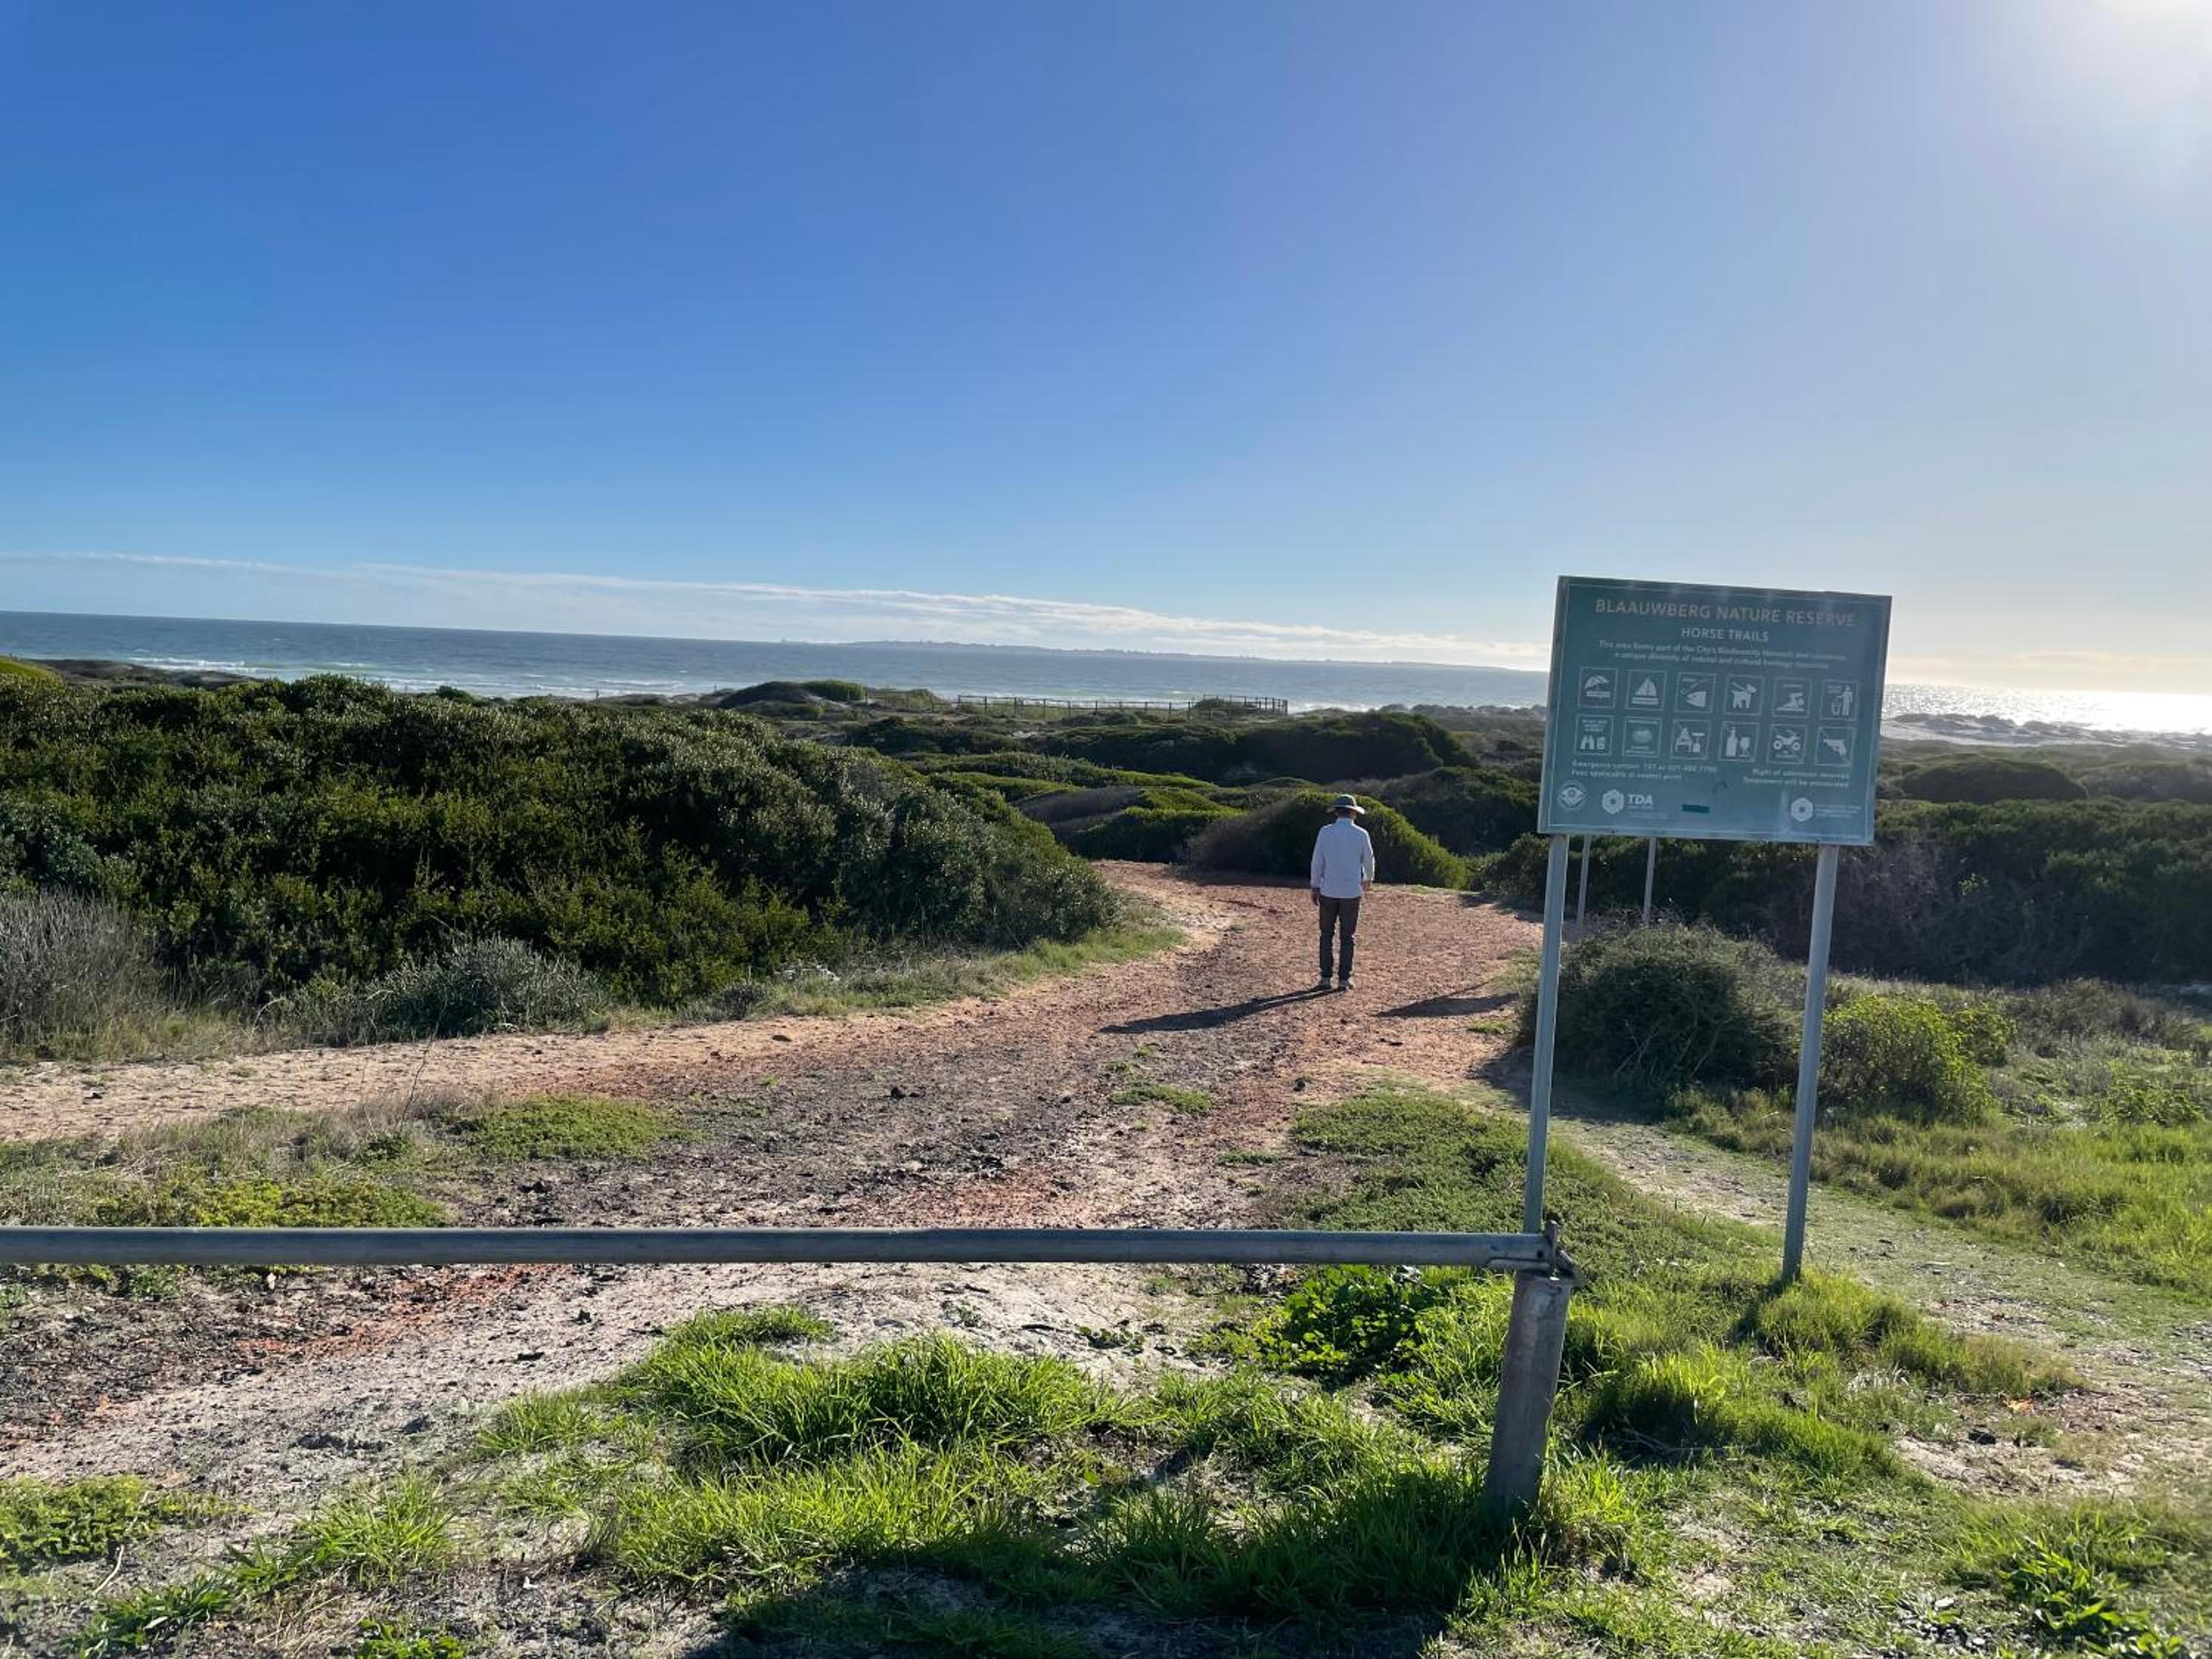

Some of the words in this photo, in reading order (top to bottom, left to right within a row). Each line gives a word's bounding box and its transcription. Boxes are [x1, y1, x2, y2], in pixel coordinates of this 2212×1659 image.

[1595, 599, 1711, 619] BLAAUWBERG
[1716, 605, 1781, 623] NATURE
[1785, 609, 1857, 627] RESERVE
[1681, 627, 1724, 640] HORSE
[1728, 630, 1770, 642] TRAILS
[1627, 794, 1653, 805] TDA
